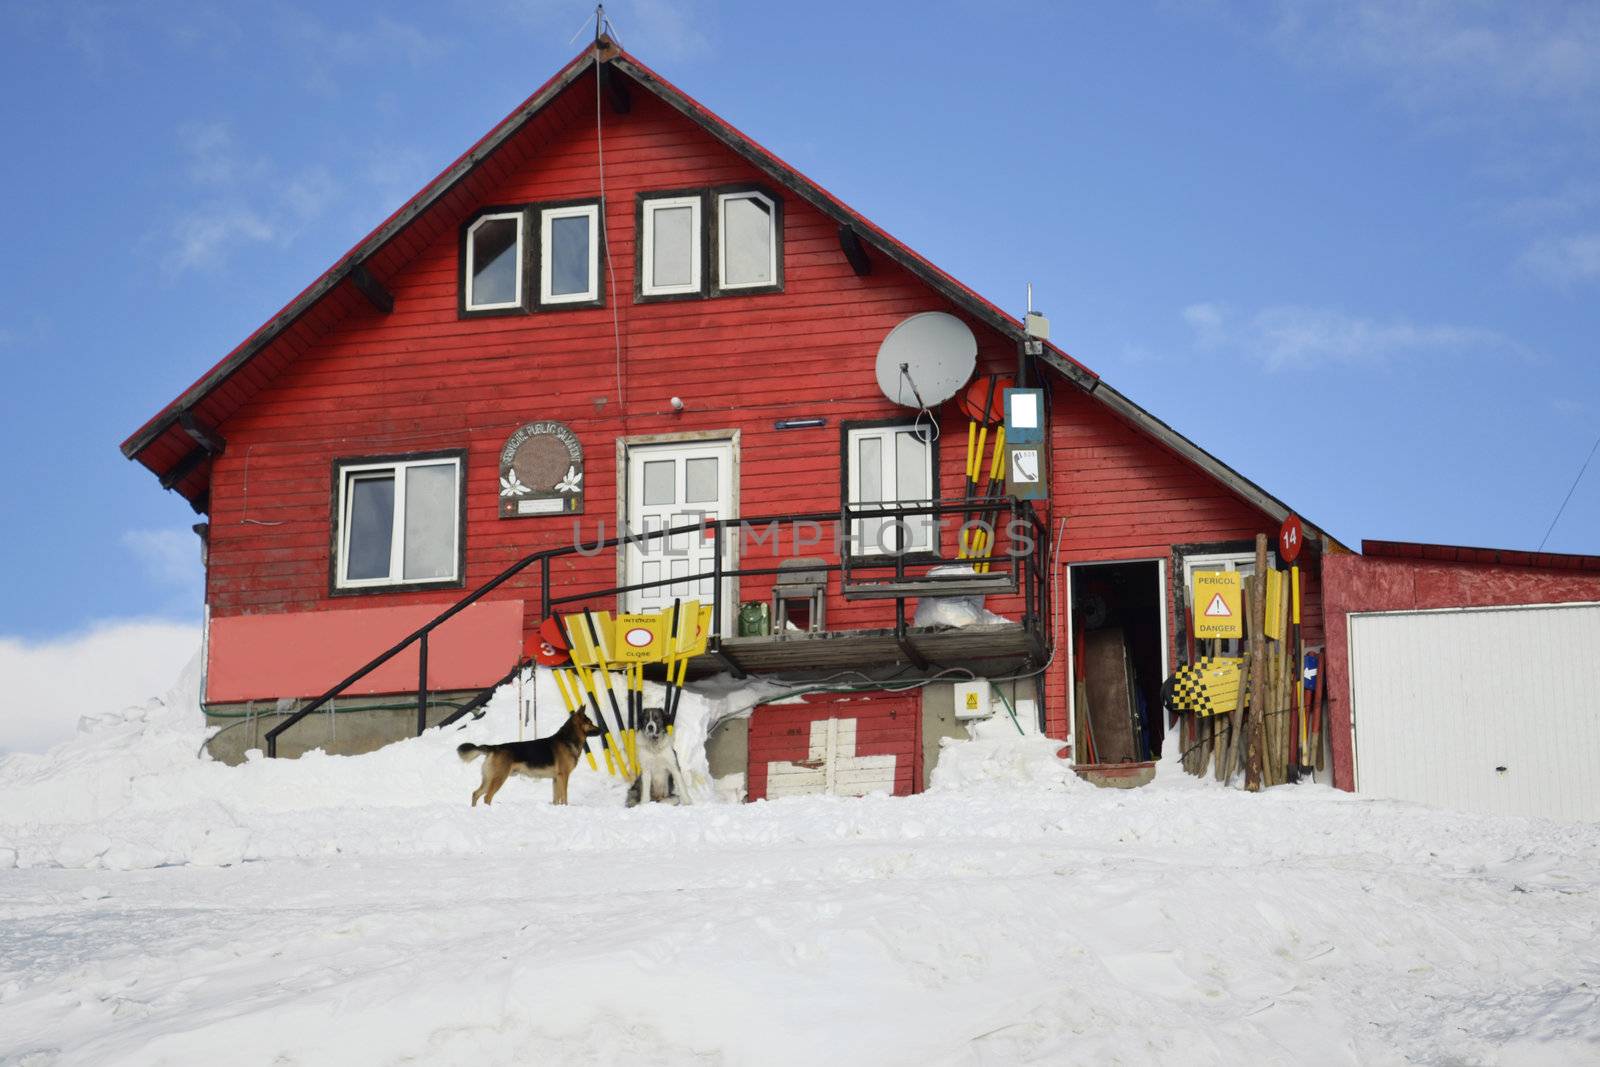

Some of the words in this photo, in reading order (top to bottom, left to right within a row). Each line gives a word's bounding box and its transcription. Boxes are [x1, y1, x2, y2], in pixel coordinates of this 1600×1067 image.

[526, 423, 557, 436] PUBLIC
[1283, 527, 1297, 549] 14
[1198, 577, 1236, 585] PERICOL
